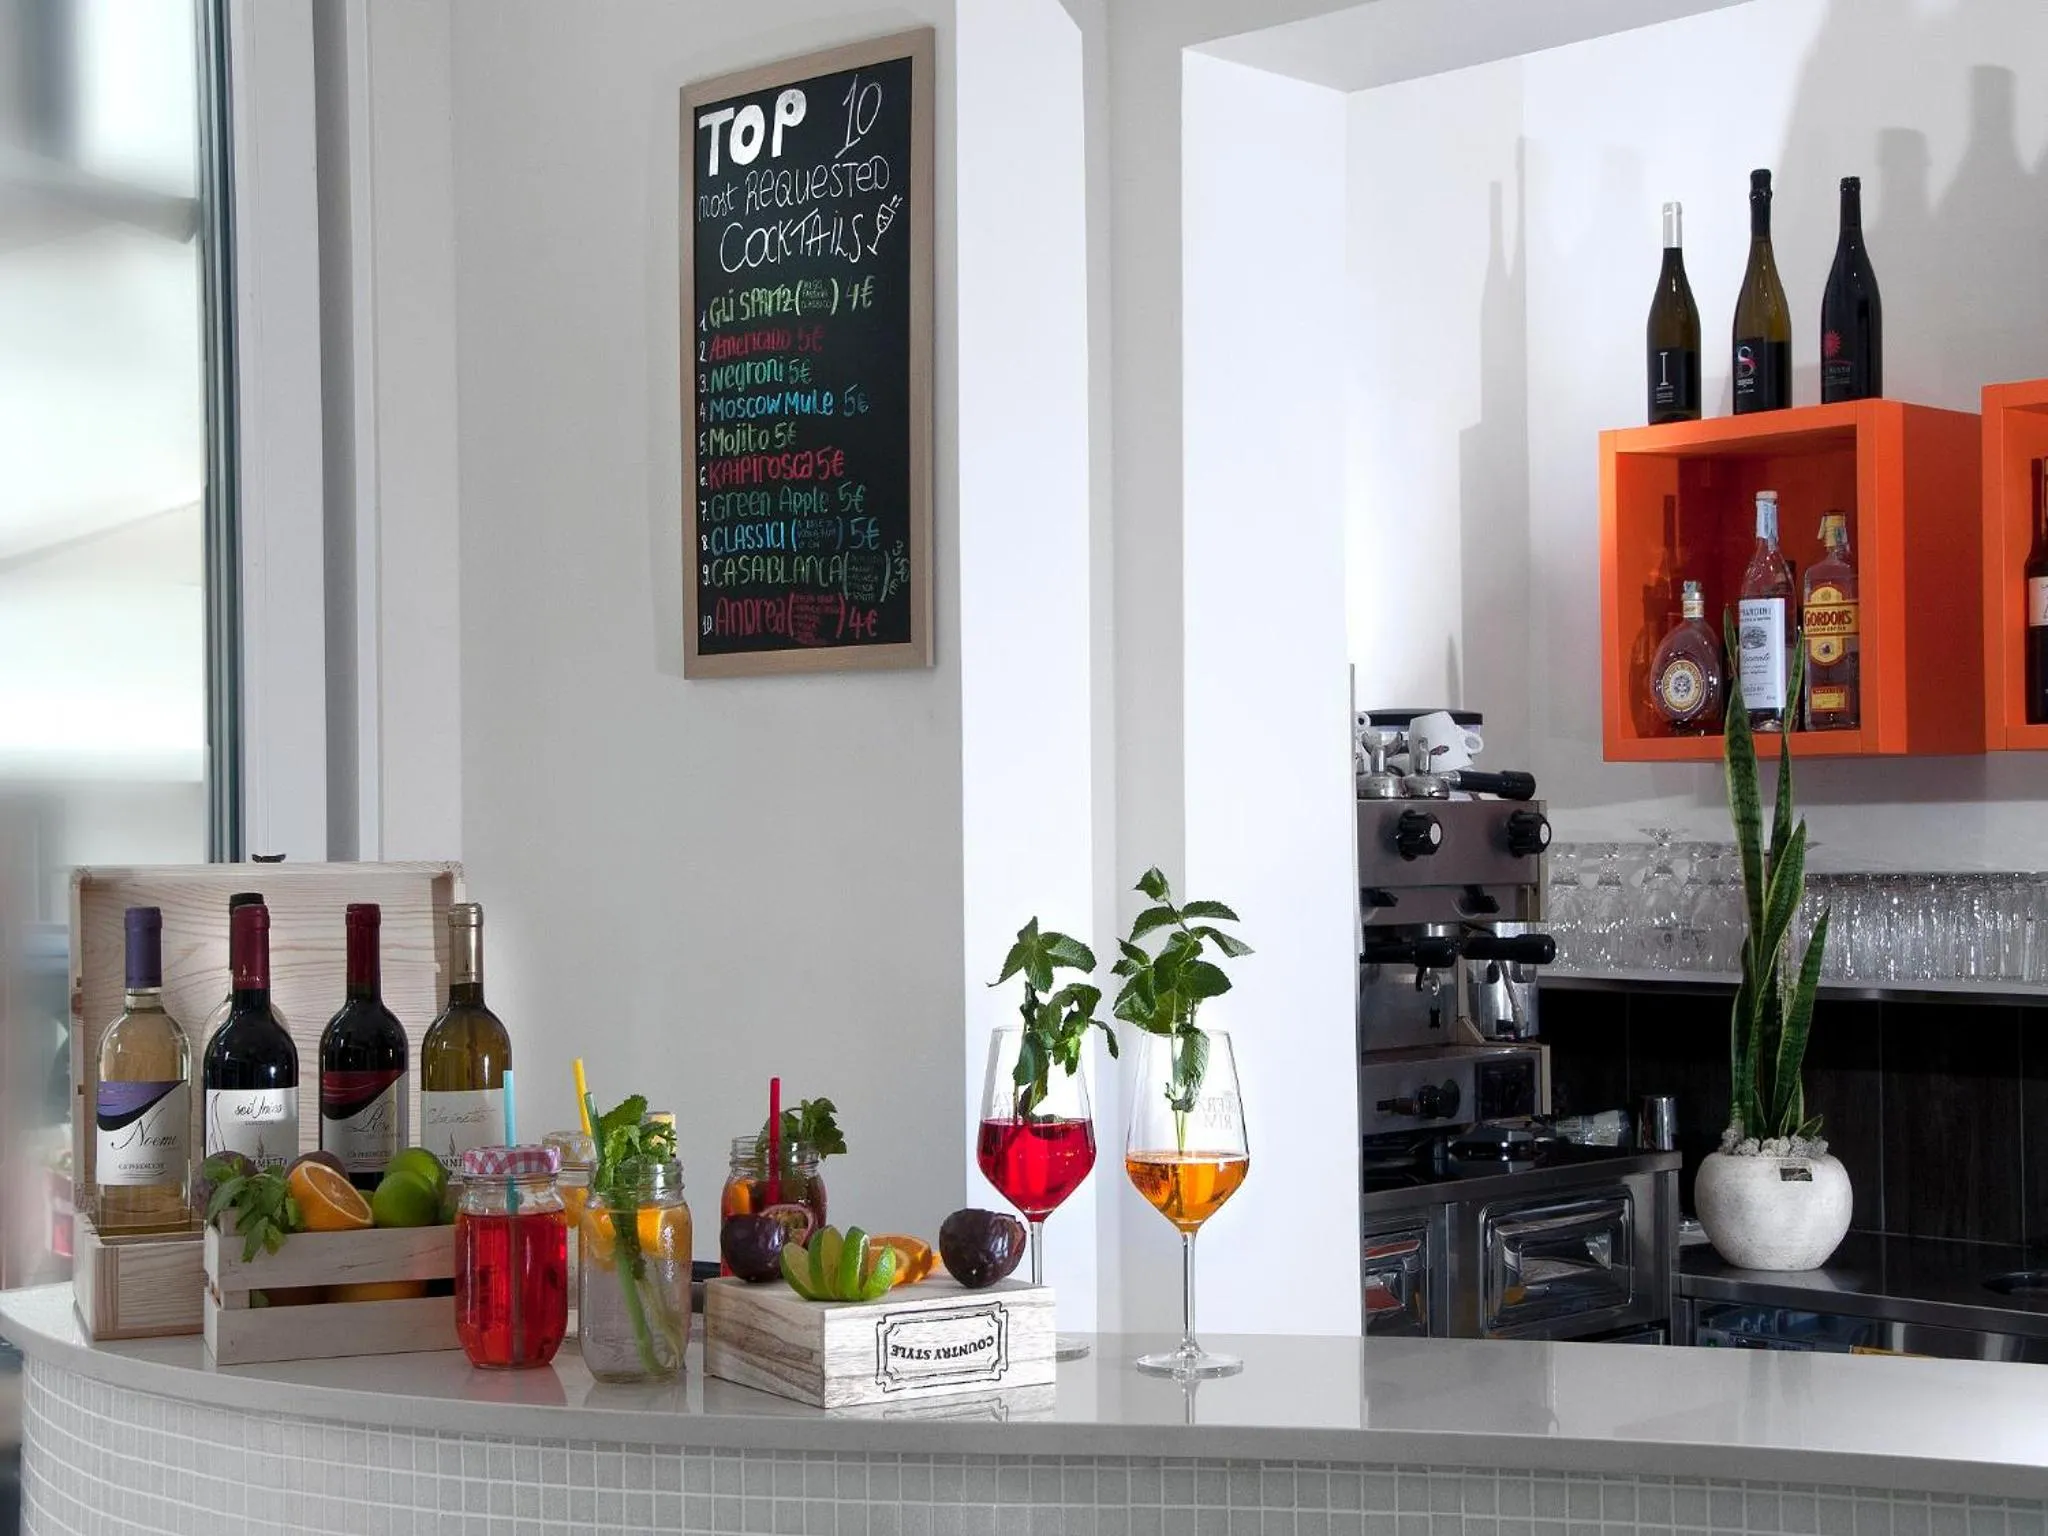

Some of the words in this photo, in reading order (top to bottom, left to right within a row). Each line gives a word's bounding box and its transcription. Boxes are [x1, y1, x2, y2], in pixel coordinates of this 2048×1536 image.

[699, 88, 807, 176] TOP
[835, 73, 883, 159] 10
[710, 355, 783, 393] Negroni
[709, 422, 769, 456] Mojito
[817, 445, 845, 480] 5€
[710, 491, 771, 522] Green
[779, 484, 830, 517] Apple
[838, 481, 866, 513] 5€
[849, 517, 881, 550] 5€
[849, 606, 878, 639] 4€
[890, 1344, 932, 1360] STYLE
[934, 1335, 995, 1360] COUNTRY
